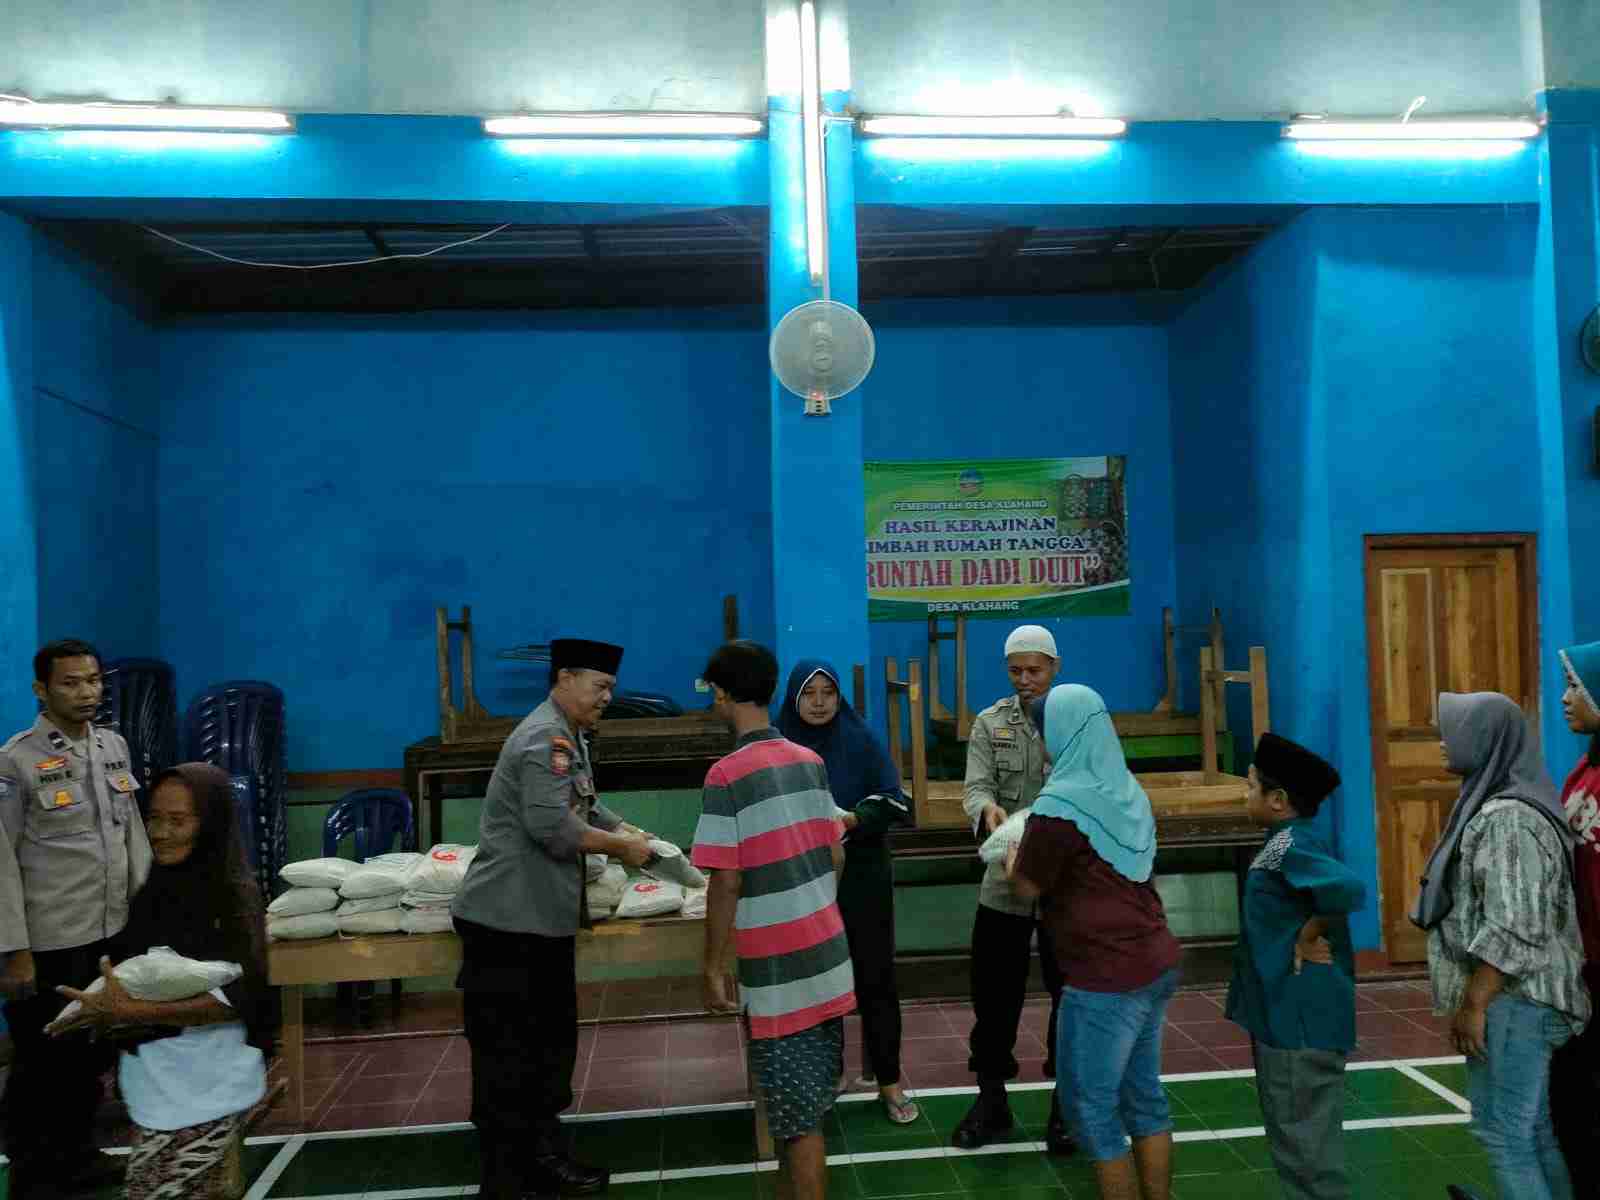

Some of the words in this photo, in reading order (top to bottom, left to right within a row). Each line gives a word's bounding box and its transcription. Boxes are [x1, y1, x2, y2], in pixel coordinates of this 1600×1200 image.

[966, 500, 993, 510] DESA
[886, 520, 941, 533] HASIL
[944, 518, 1056, 532] KERAJINAN
[865, 541, 929, 553] IMBAH
[934, 539, 1001, 552] RUMAH
[1007, 537, 1085, 550] TANGGA
[961, 558, 1023, 586] DADI
[928, 602, 959, 613] DESA
